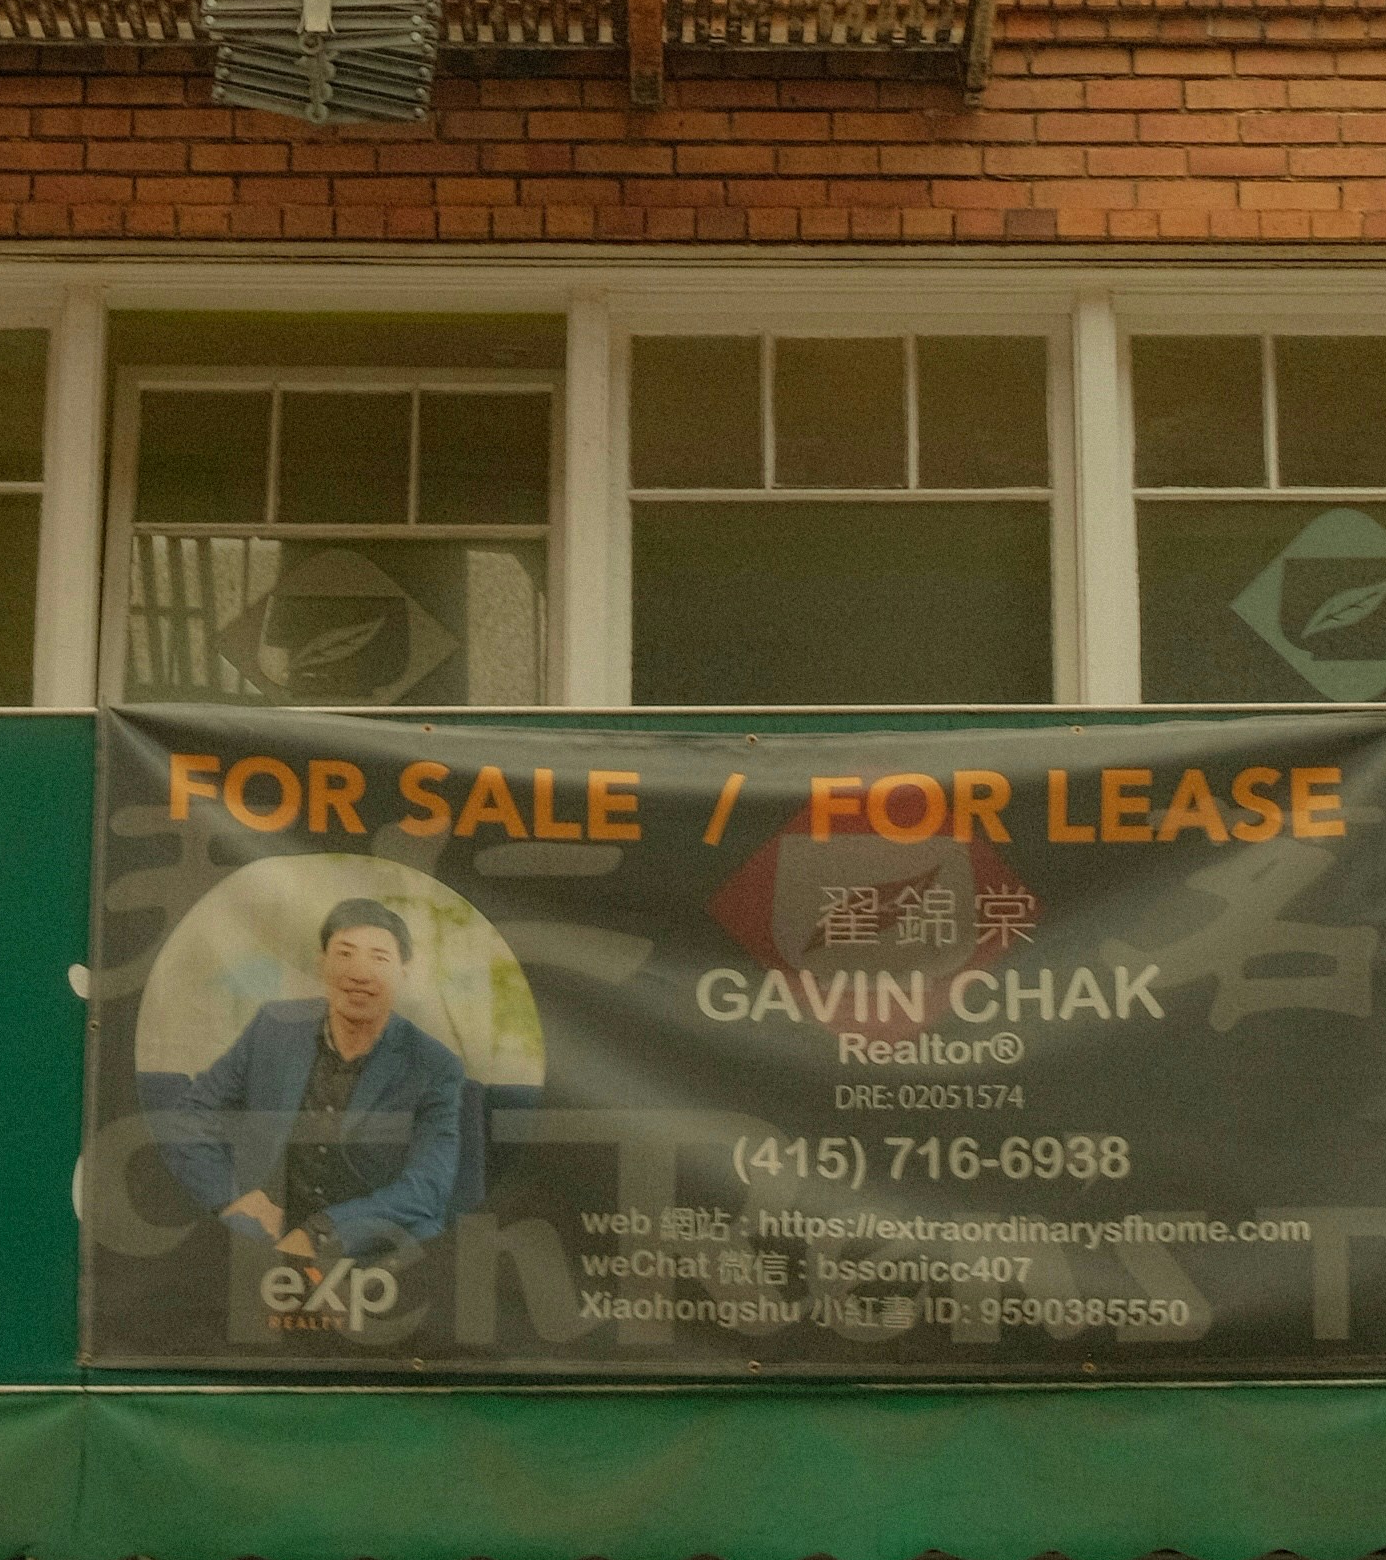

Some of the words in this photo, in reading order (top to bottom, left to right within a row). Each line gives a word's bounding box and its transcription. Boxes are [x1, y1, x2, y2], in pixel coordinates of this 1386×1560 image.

[170, 753, 366, 834] FOR
[398, 761, 642, 841] SALE
[702, 772, 746, 846] /
[811, 769, 1012, 843] FOR
[1046, 766, 1346, 843] LEASE
[815, 884, 1036, 948] 翟錦棠
[694, 968, 926, 1023] GAVIN
[948, 964, 1166, 1023] CHAK
[834, 1085, 893, 1110] DRE:
[898, 1085, 1025, 1111] 02051574
[732, 1137, 868, 1190] (415)
[884, 1136, 1131, 1180] 716-6938
[580, 1208, 651, 1236] web
[581, 1250, 709, 1278] weChat
[816, 1253, 1033, 1282] bssonicc407
[579, 1290, 802, 1326] Xiaohongshu
[923, 1297, 970, 1324] ID:
[979, 1298, 1190, 1327] 9590385550
